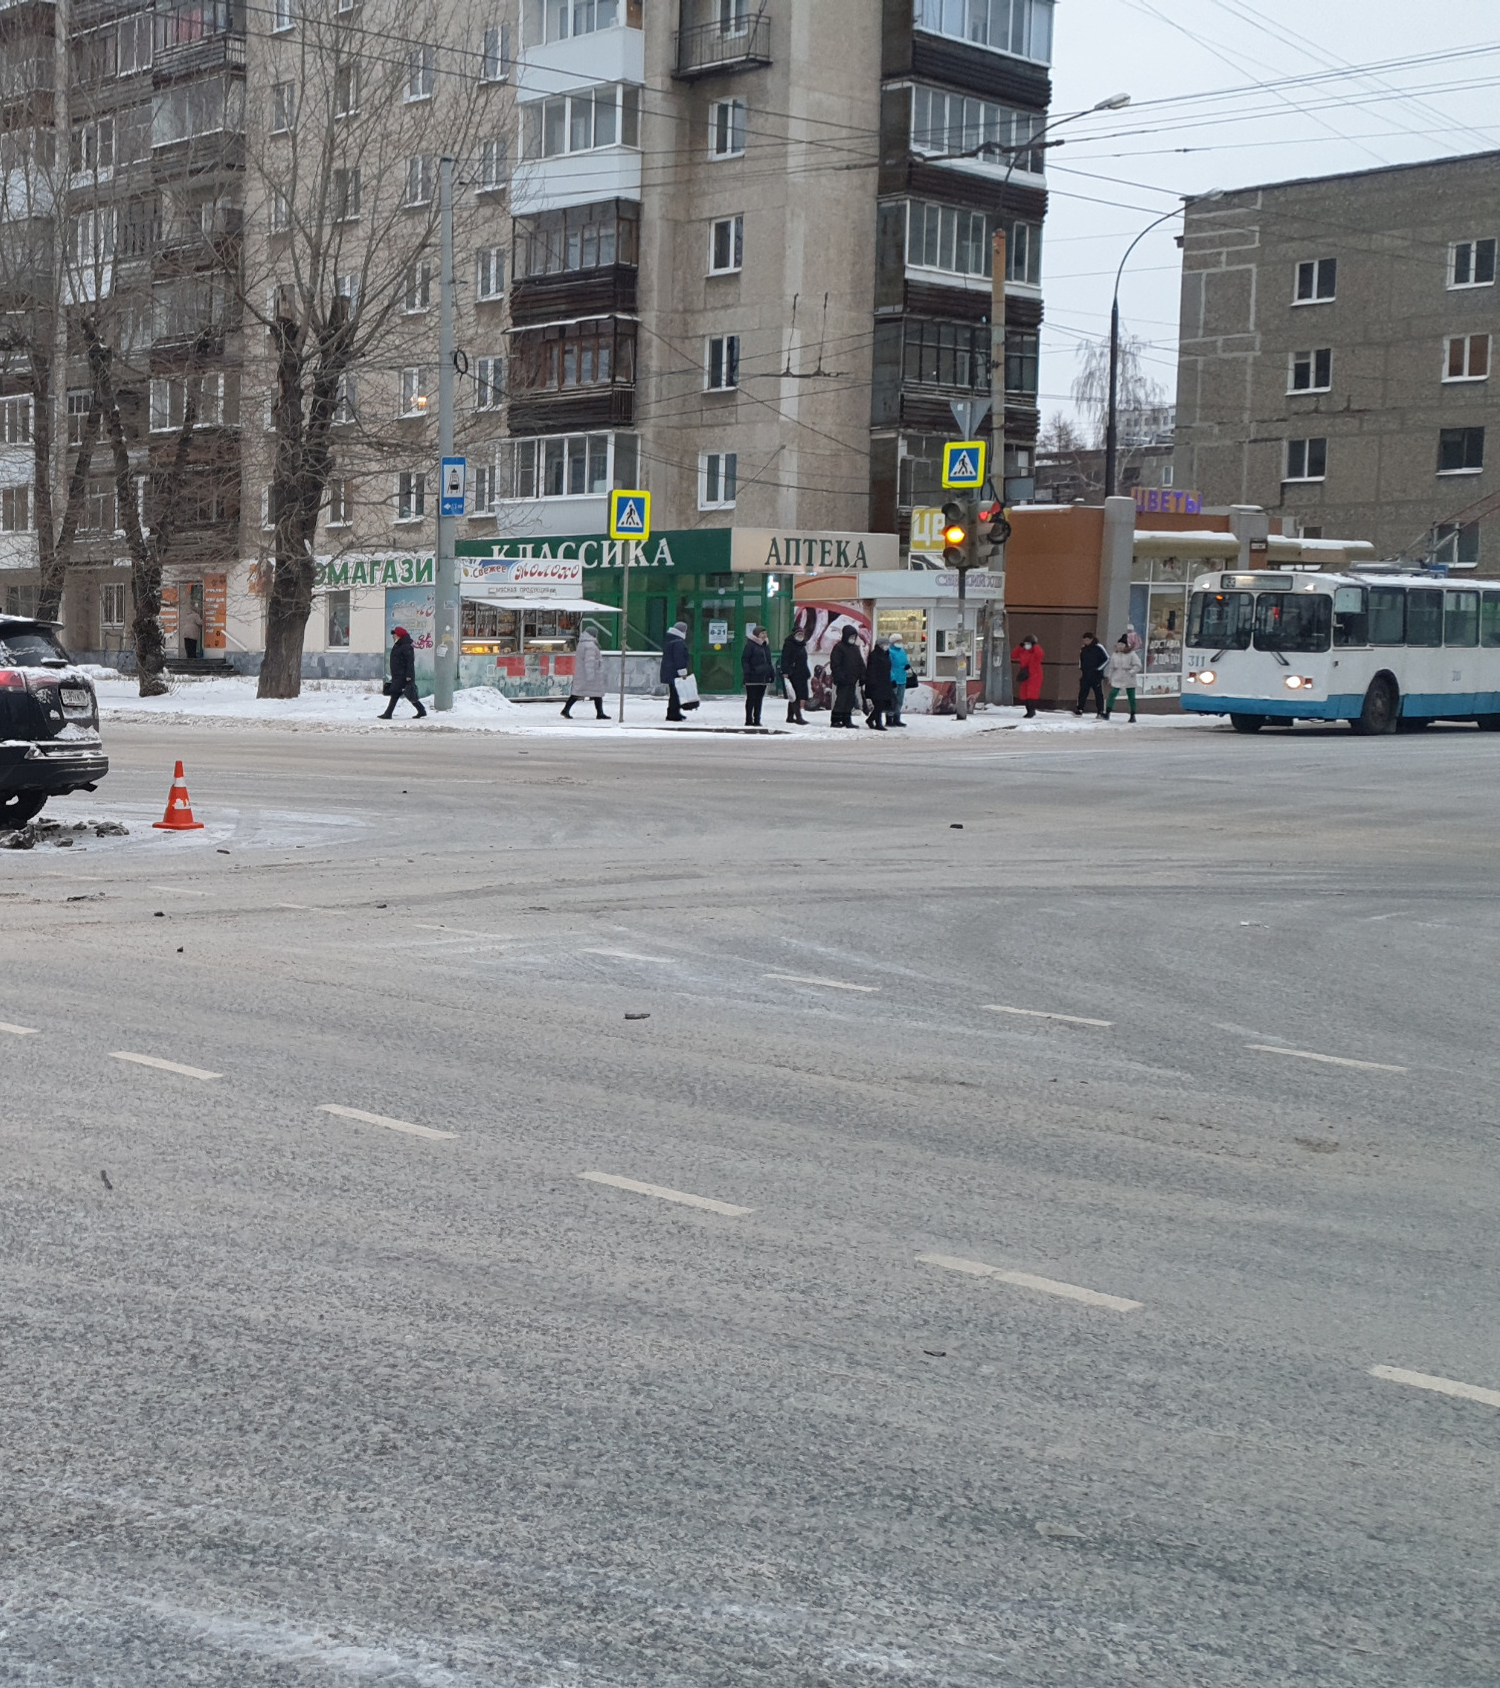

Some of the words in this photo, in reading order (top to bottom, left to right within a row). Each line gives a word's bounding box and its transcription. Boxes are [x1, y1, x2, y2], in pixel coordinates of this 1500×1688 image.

[1134, 488, 1203, 514] ЦВЕТЫ
[913, 512, 946, 547] ЦВ
[490, 537, 675, 568] КЛАССИКА
[764, 536, 869, 569] АПТЕКА
[314, 558, 434, 586] ОМАГАЗИ
[1187, 655, 1206, 668] 311
